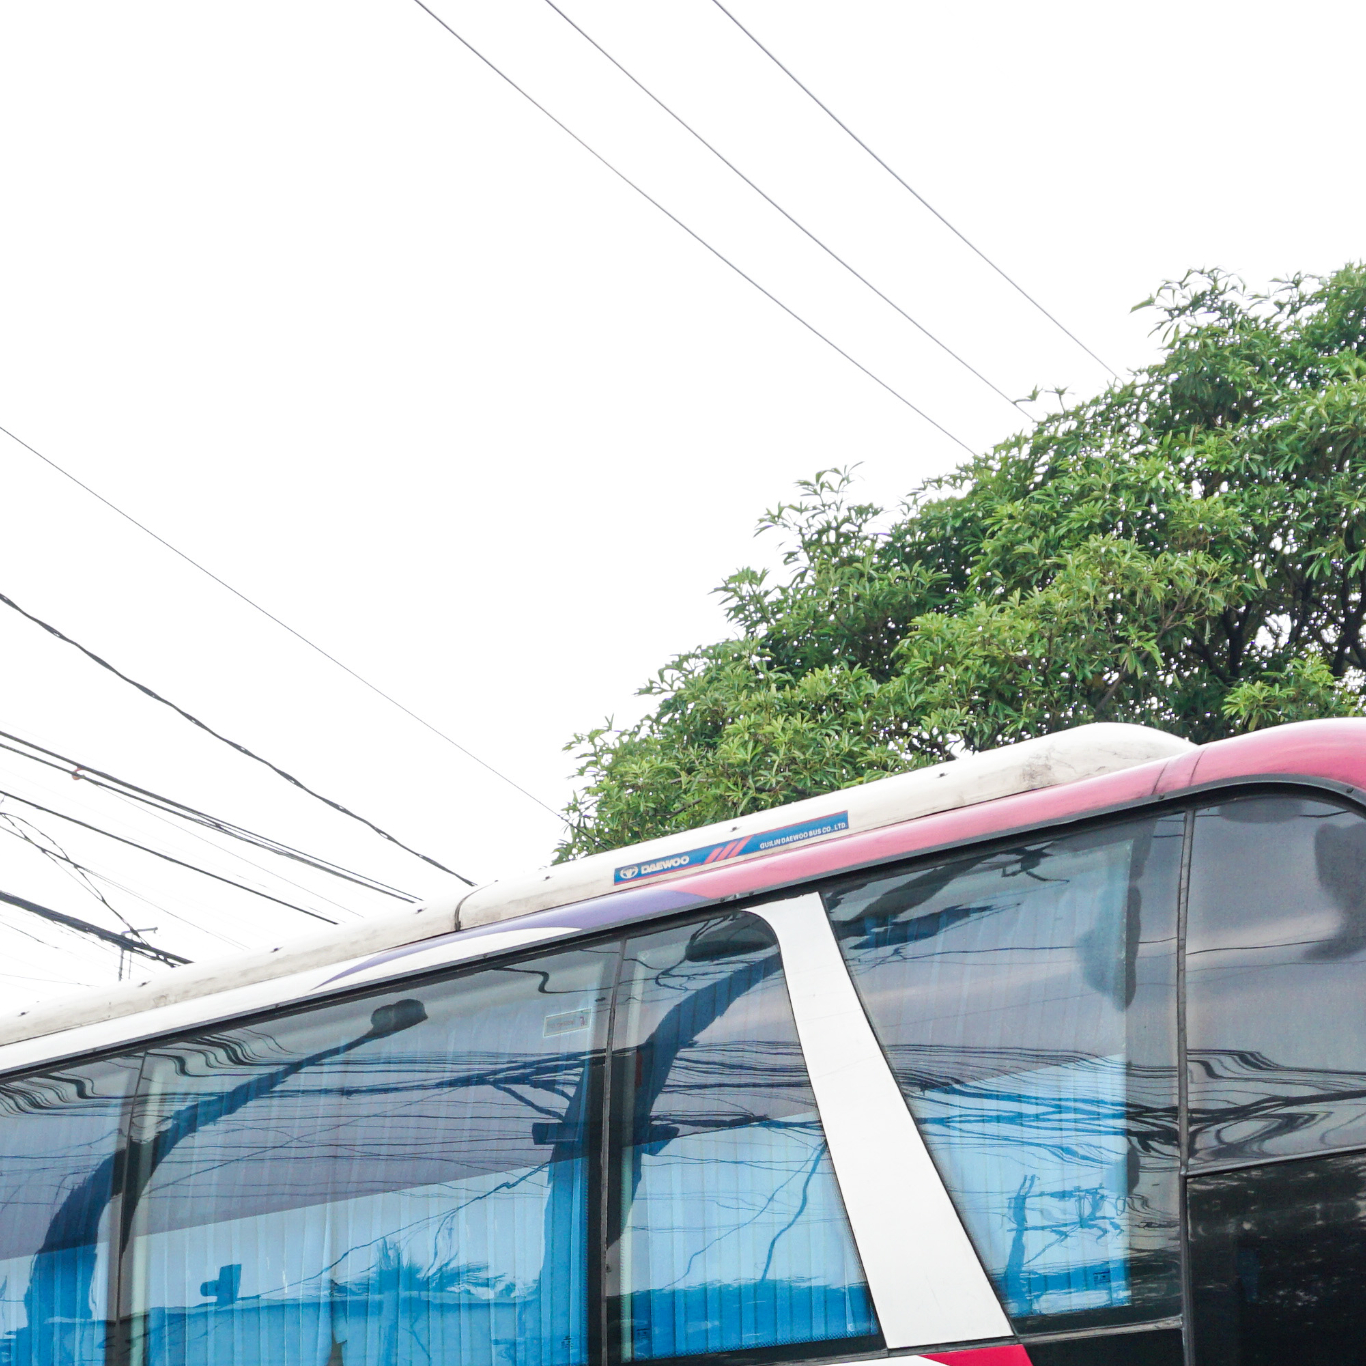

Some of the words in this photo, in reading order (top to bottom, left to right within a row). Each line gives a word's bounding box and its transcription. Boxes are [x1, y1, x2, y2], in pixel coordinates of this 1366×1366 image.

[781, 832, 808, 844] DAEWOO
[808, 828, 822, 837] BUS
[640, 855, 690, 875] DAEWOO
